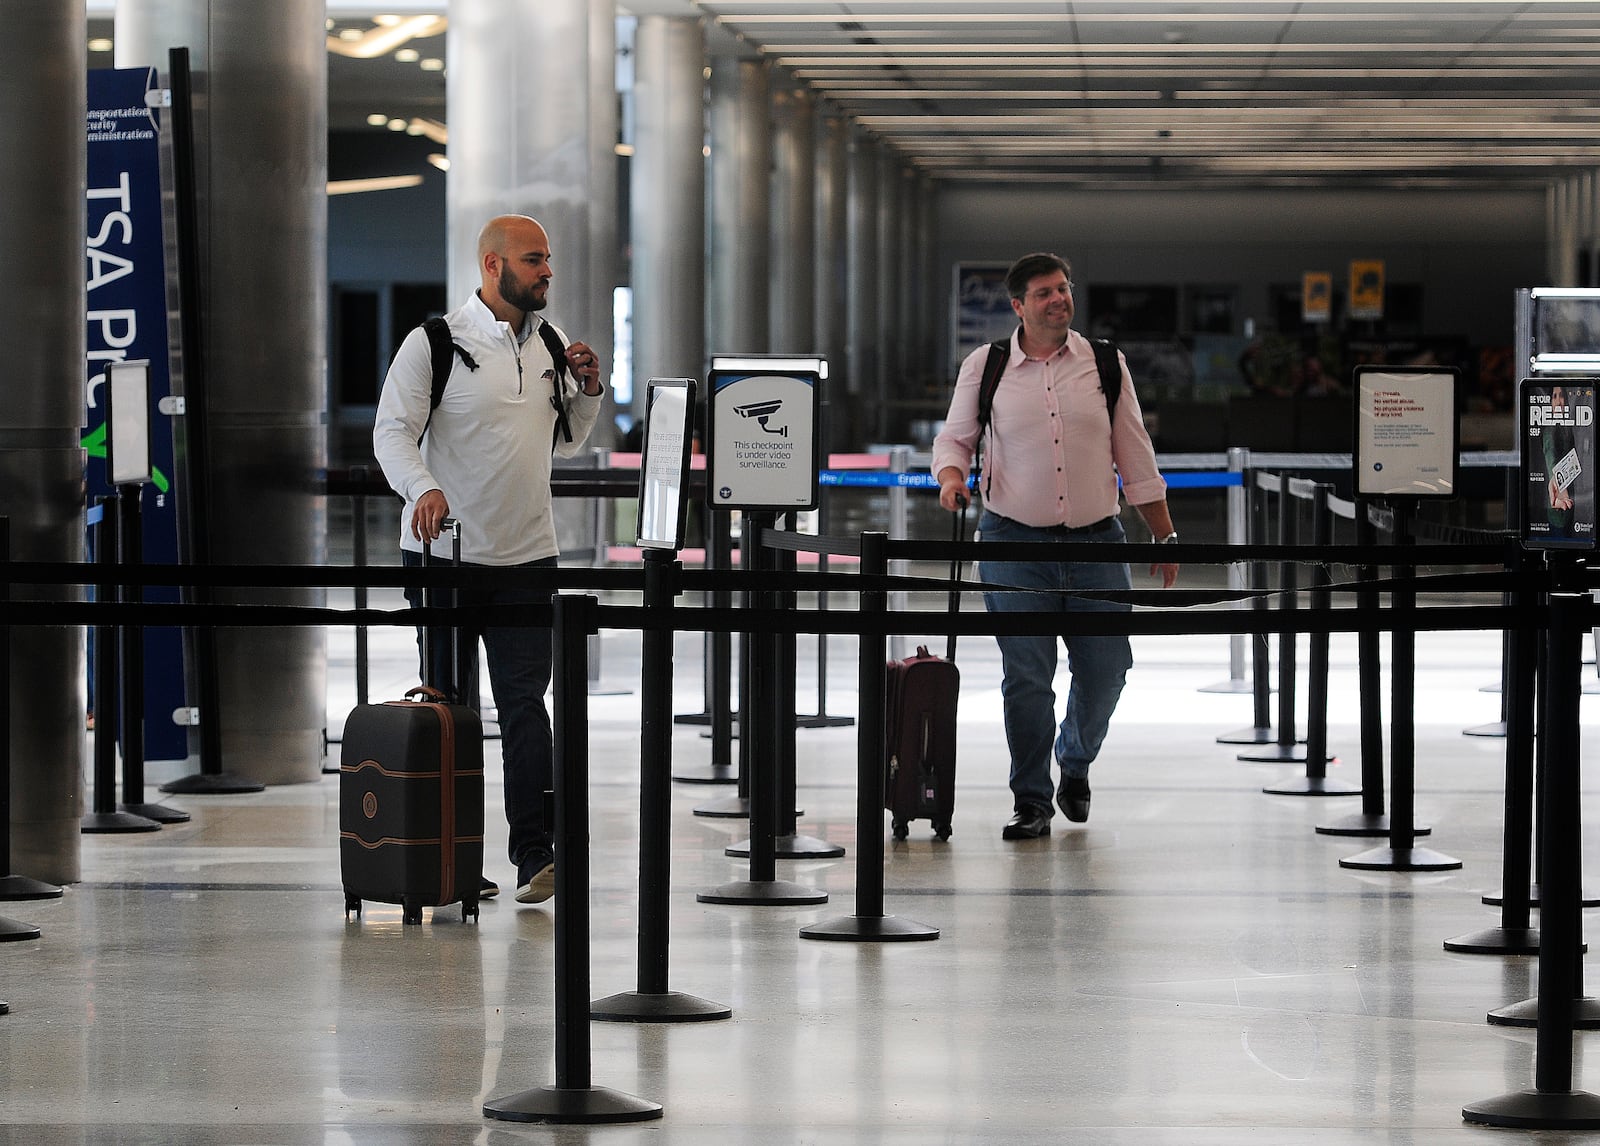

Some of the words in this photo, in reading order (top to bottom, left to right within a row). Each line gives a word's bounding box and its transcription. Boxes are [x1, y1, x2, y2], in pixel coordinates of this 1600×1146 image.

[87, 129, 153, 142] ministration
[87, 172, 134, 291] TSA
[1530, 395, 1536, 404] BE
[1537, 395, 1551, 404] YOUR
[1530, 405, 1575, 426] REAL
[1576, 405, 1593, 426] ID
[1530, 427, 1541, 437] SELF
[734, 441, 750, 449] This
[751, 441, 793, 451] checkpoint
[736, 450, 742, 459] is
[744, 450, 767, 459] under
[769, 450, 791, 459] video
[739, 460, 788, 469] surveillance.
